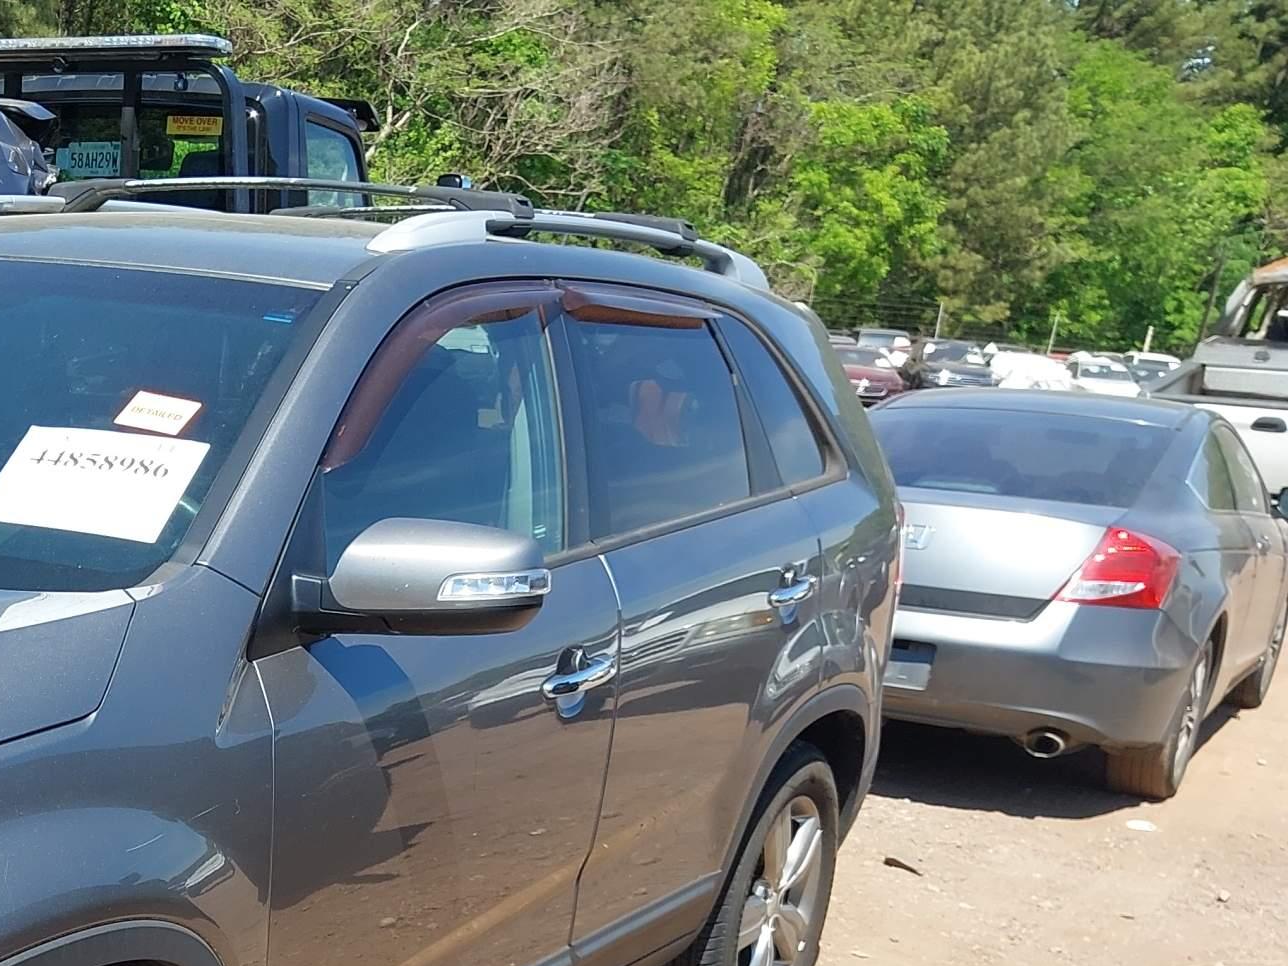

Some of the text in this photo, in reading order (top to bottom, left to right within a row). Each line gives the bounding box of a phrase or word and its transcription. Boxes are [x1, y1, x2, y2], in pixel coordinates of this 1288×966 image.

[172, 117, 217, 126] MOVE OVER
[130, 406, 183, 421] DETAILED
[30, 448, 169, 478] 44858986
